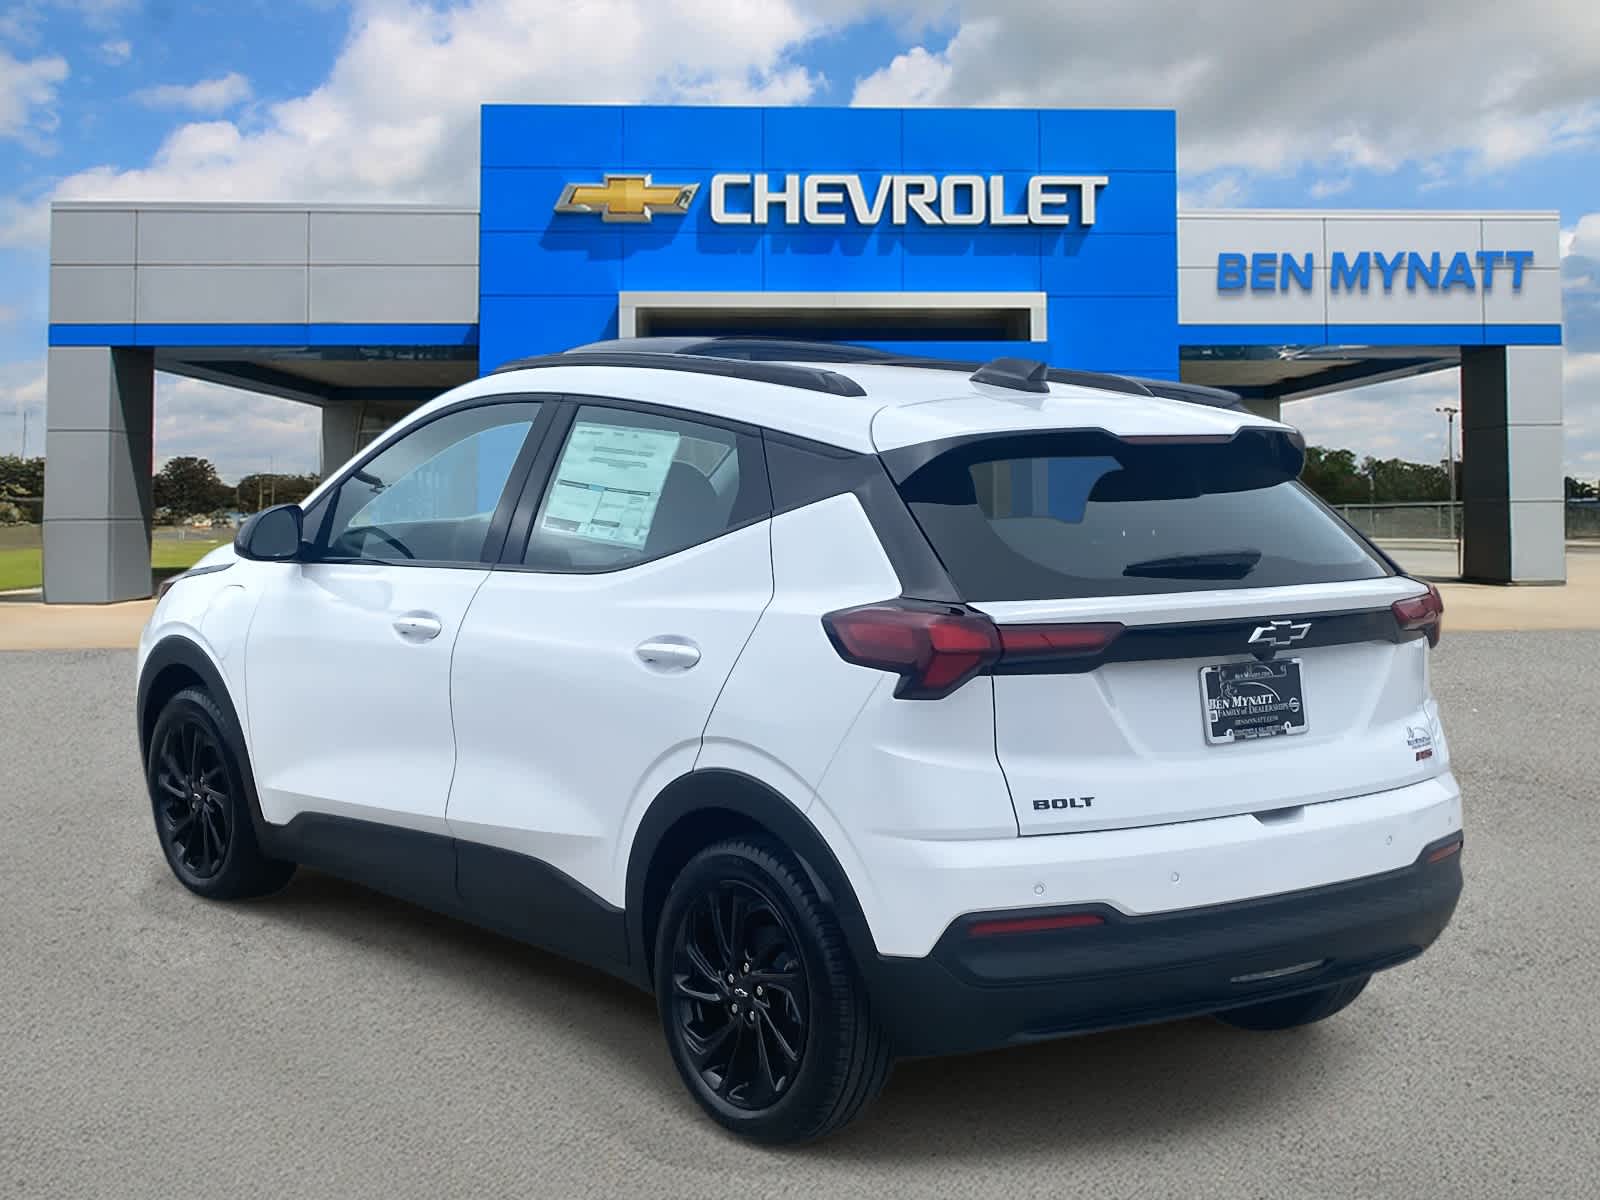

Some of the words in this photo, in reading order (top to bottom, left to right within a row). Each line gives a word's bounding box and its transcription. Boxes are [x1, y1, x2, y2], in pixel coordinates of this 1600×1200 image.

[710, 174, 1110, 226] CHEVROLET
[1217, 252, 1314, 291] BEN
[1330, 250, 1535, 290] MYNATT
[1208, 699, 1230, 711] BEN
[1231, 694, 1275, 708] MYNATT
[1032, 796, 1096, 811] BOLT
